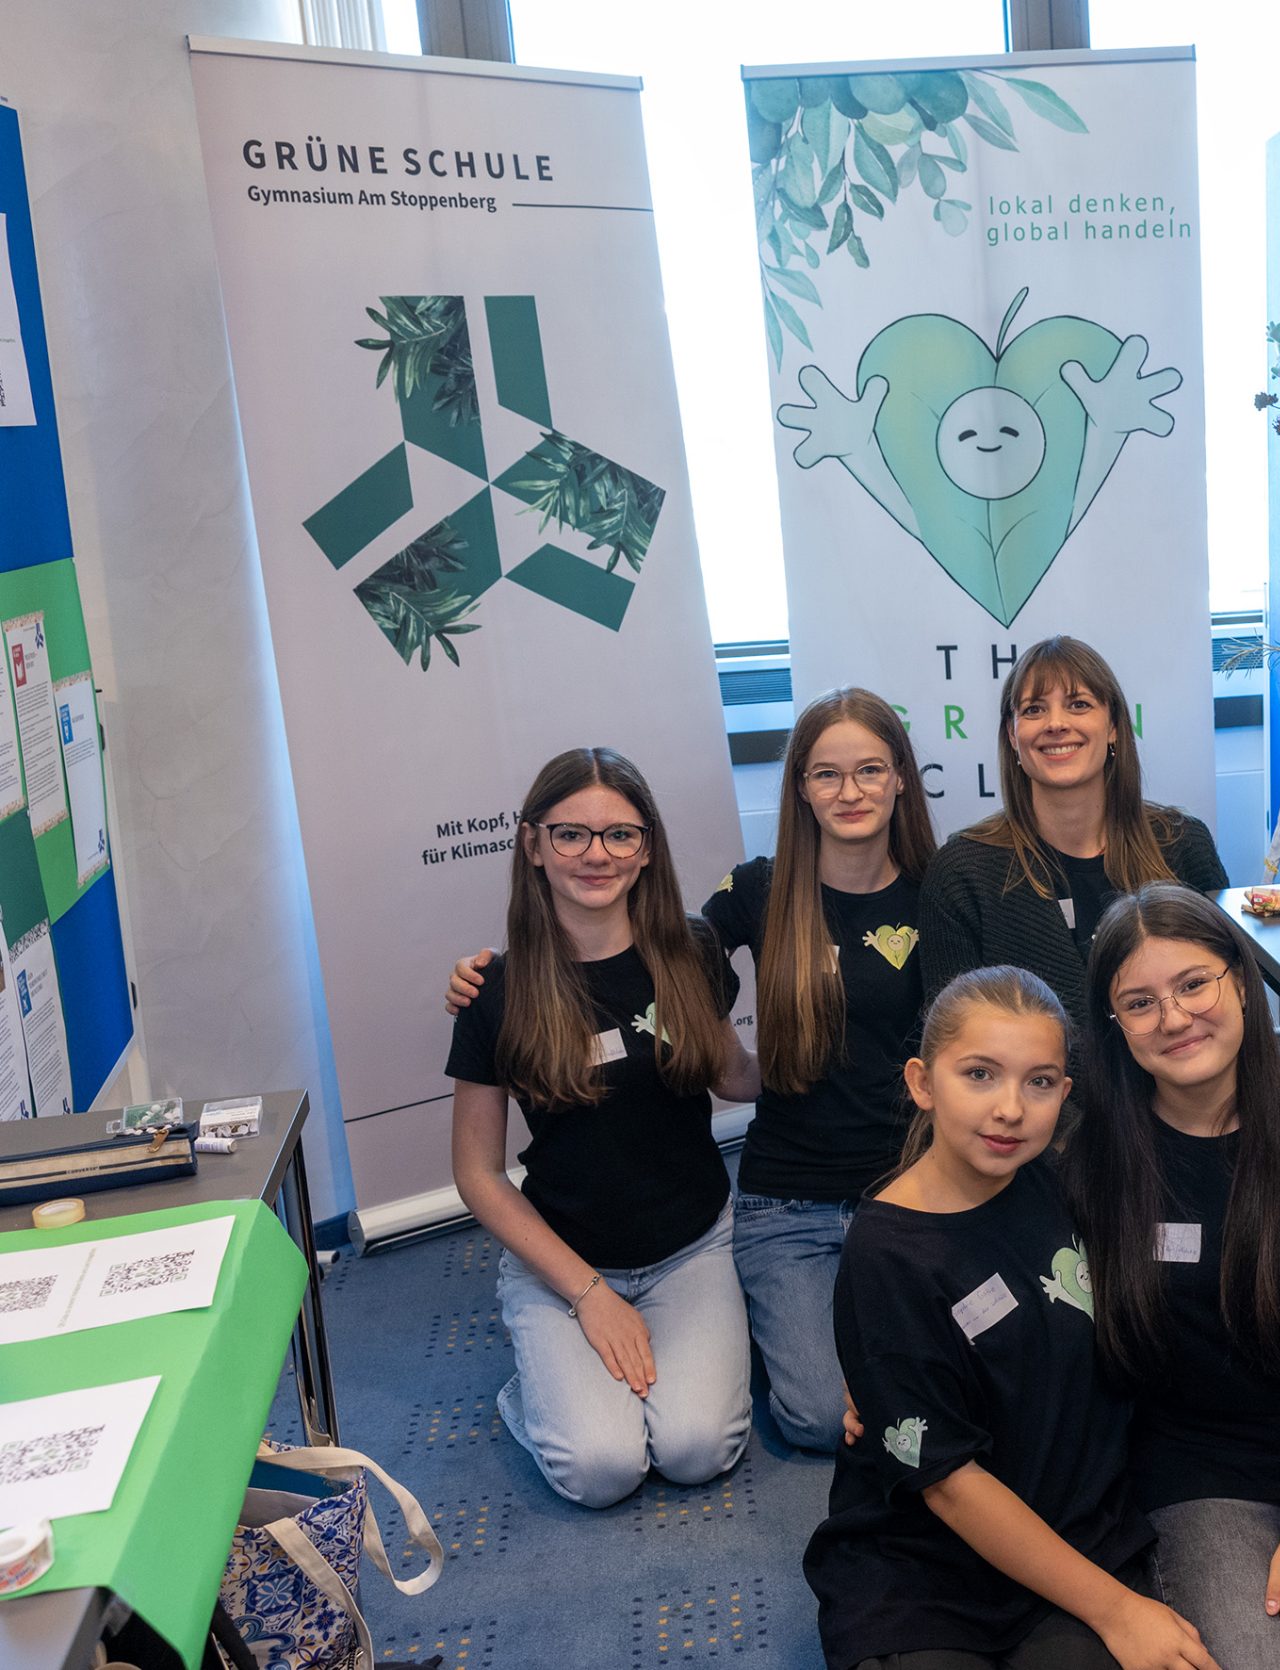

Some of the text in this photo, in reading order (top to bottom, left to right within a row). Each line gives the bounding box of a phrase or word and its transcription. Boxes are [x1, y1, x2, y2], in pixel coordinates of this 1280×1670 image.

[242, 135, 553, 181] GRÜNE SCHULE
[247, 185, 497, 213] Gymnasium Am Stoppenberg
[989, 193, 1175, 215] lokal denken,
[987, 219, 1191, 246] global handeln
[936, 644, 1017, 680] TH
[920, 763, 995, 798] CL
[436, 821, 464, 838] Mit
[467, 812, 510, 832] Kopf,
[421, 839, 514, 865] für Klimasc
